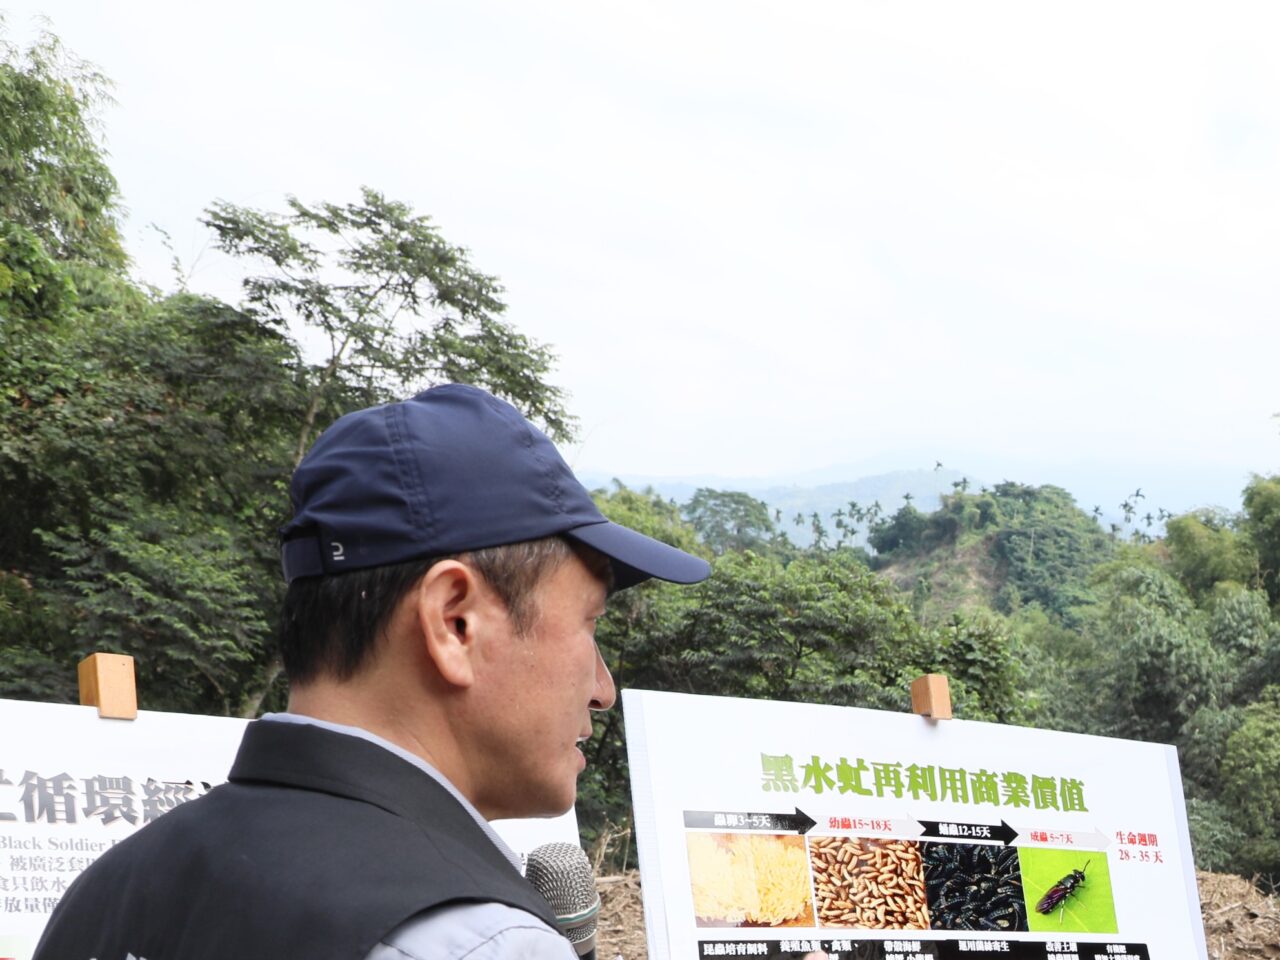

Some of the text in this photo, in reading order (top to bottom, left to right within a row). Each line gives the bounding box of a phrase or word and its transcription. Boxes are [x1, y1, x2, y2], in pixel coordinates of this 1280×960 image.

[761, 752, 1089, 813] 黑水虻再利用商業價值
[47, 837, 106, 852] Soldier
[1119, 849, 1131, 861] 28
[1139, 850, 1150, 862] 35
